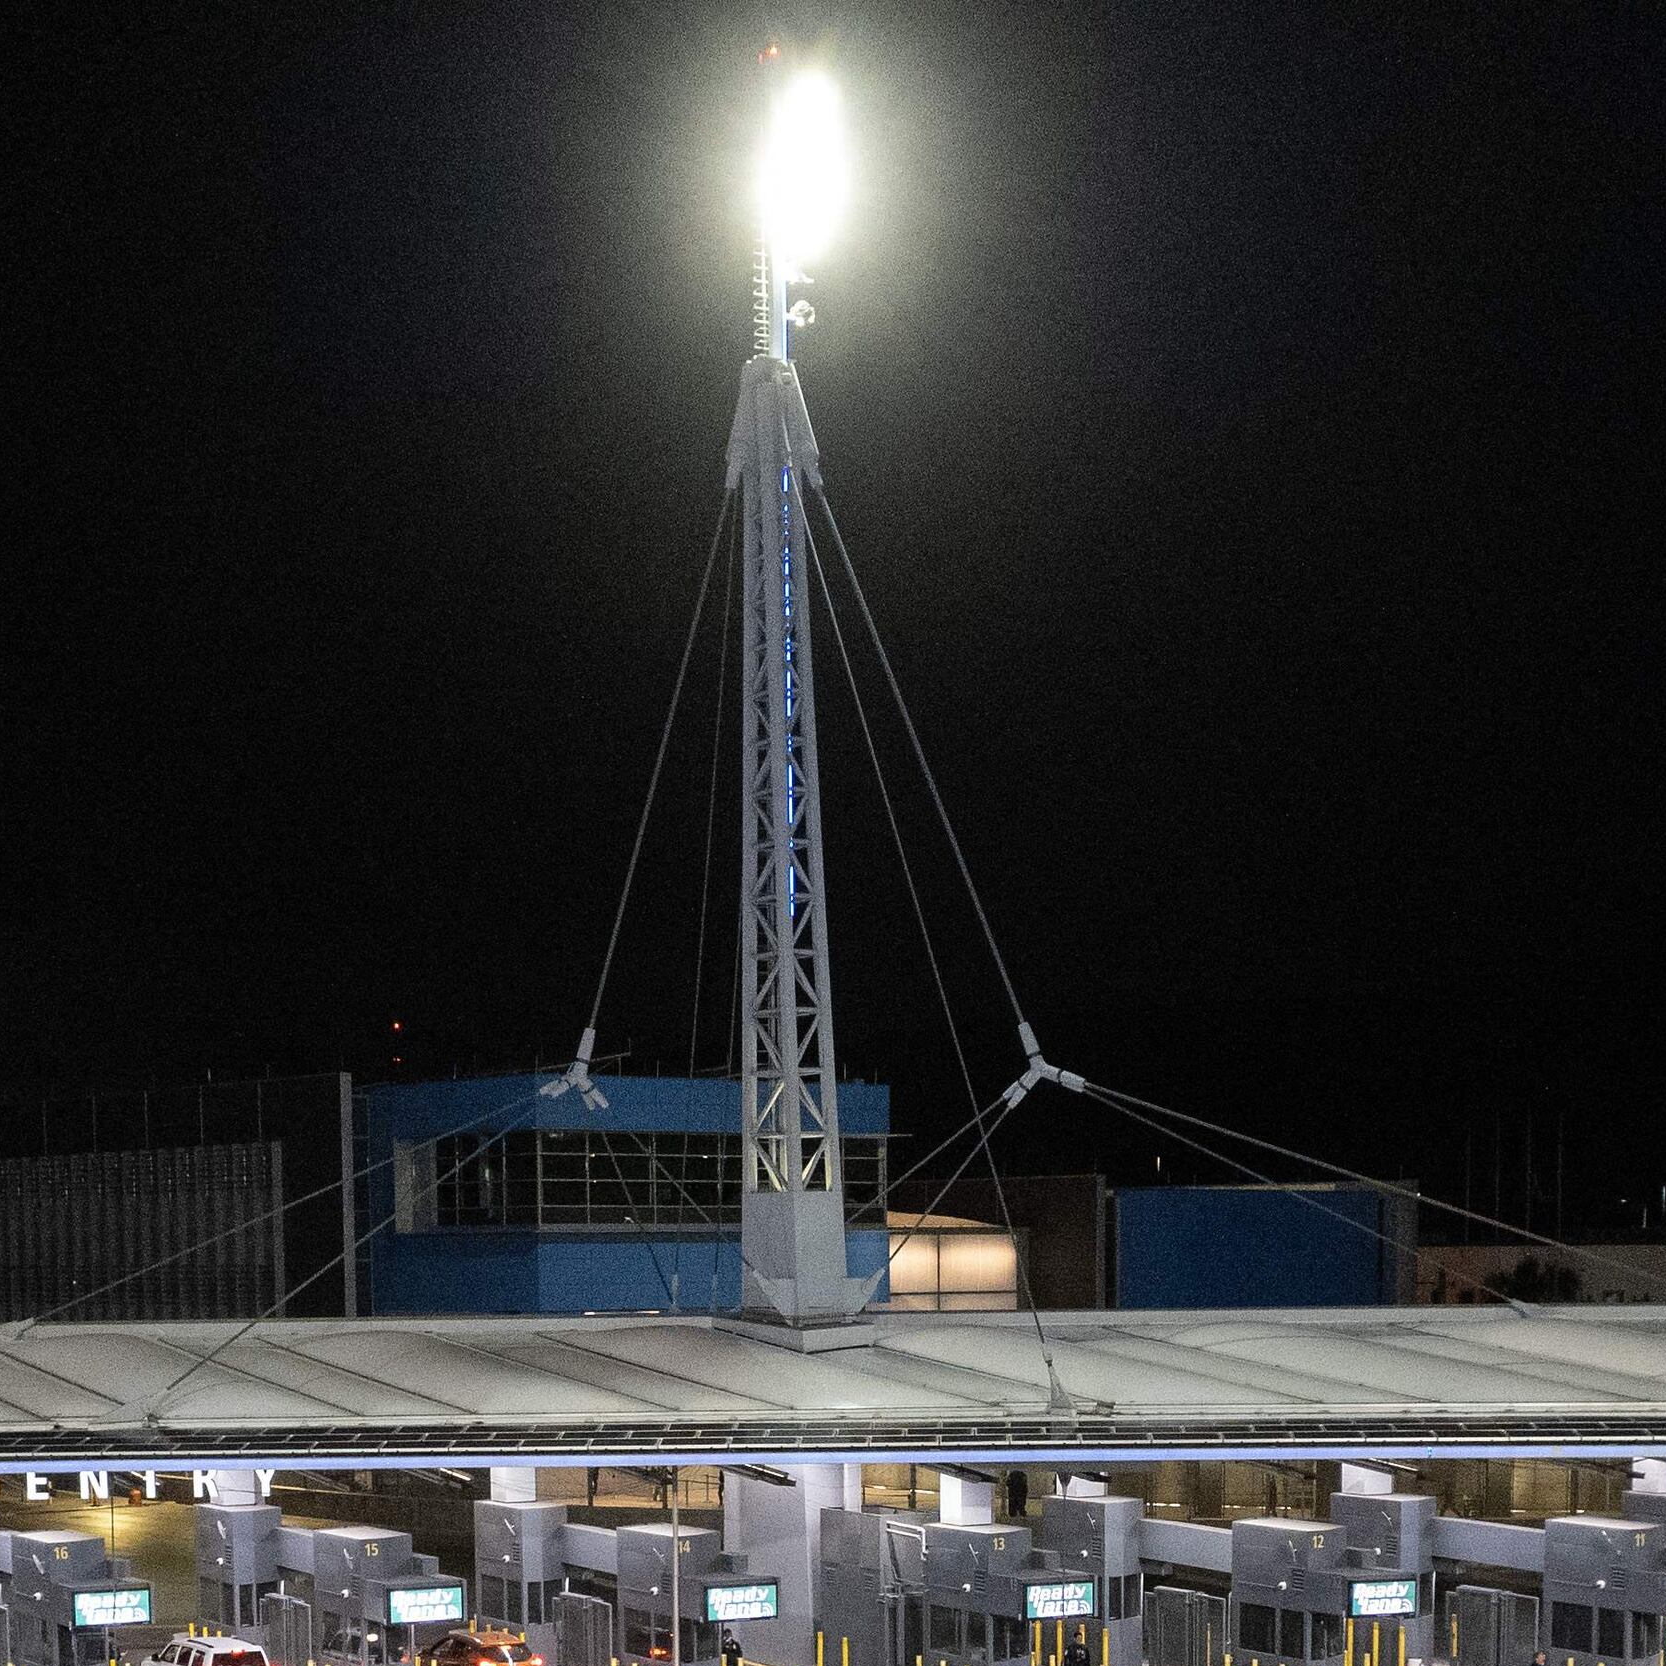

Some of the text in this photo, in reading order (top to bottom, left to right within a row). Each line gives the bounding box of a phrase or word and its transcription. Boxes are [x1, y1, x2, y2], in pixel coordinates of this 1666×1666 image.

[364, 1542, 379, 1557] 15
[679, 1540, 691, 1554] 14
[993, 1537, 1005, 1551] 13
[1312, 1535, 1324, 1549] 12
[53, 1546, 69, 1560] 16
[709, 1587, 769, 1604] Ready
[1029, 1585, 1086, 1604] Ready
[1353, 1582, 1408, 1599] Ready
[77, 1591, 142, 1609] Ready
[719, 1601, 763, 1620] Lane
[1039, 1600, 1080, 1618] Lane
